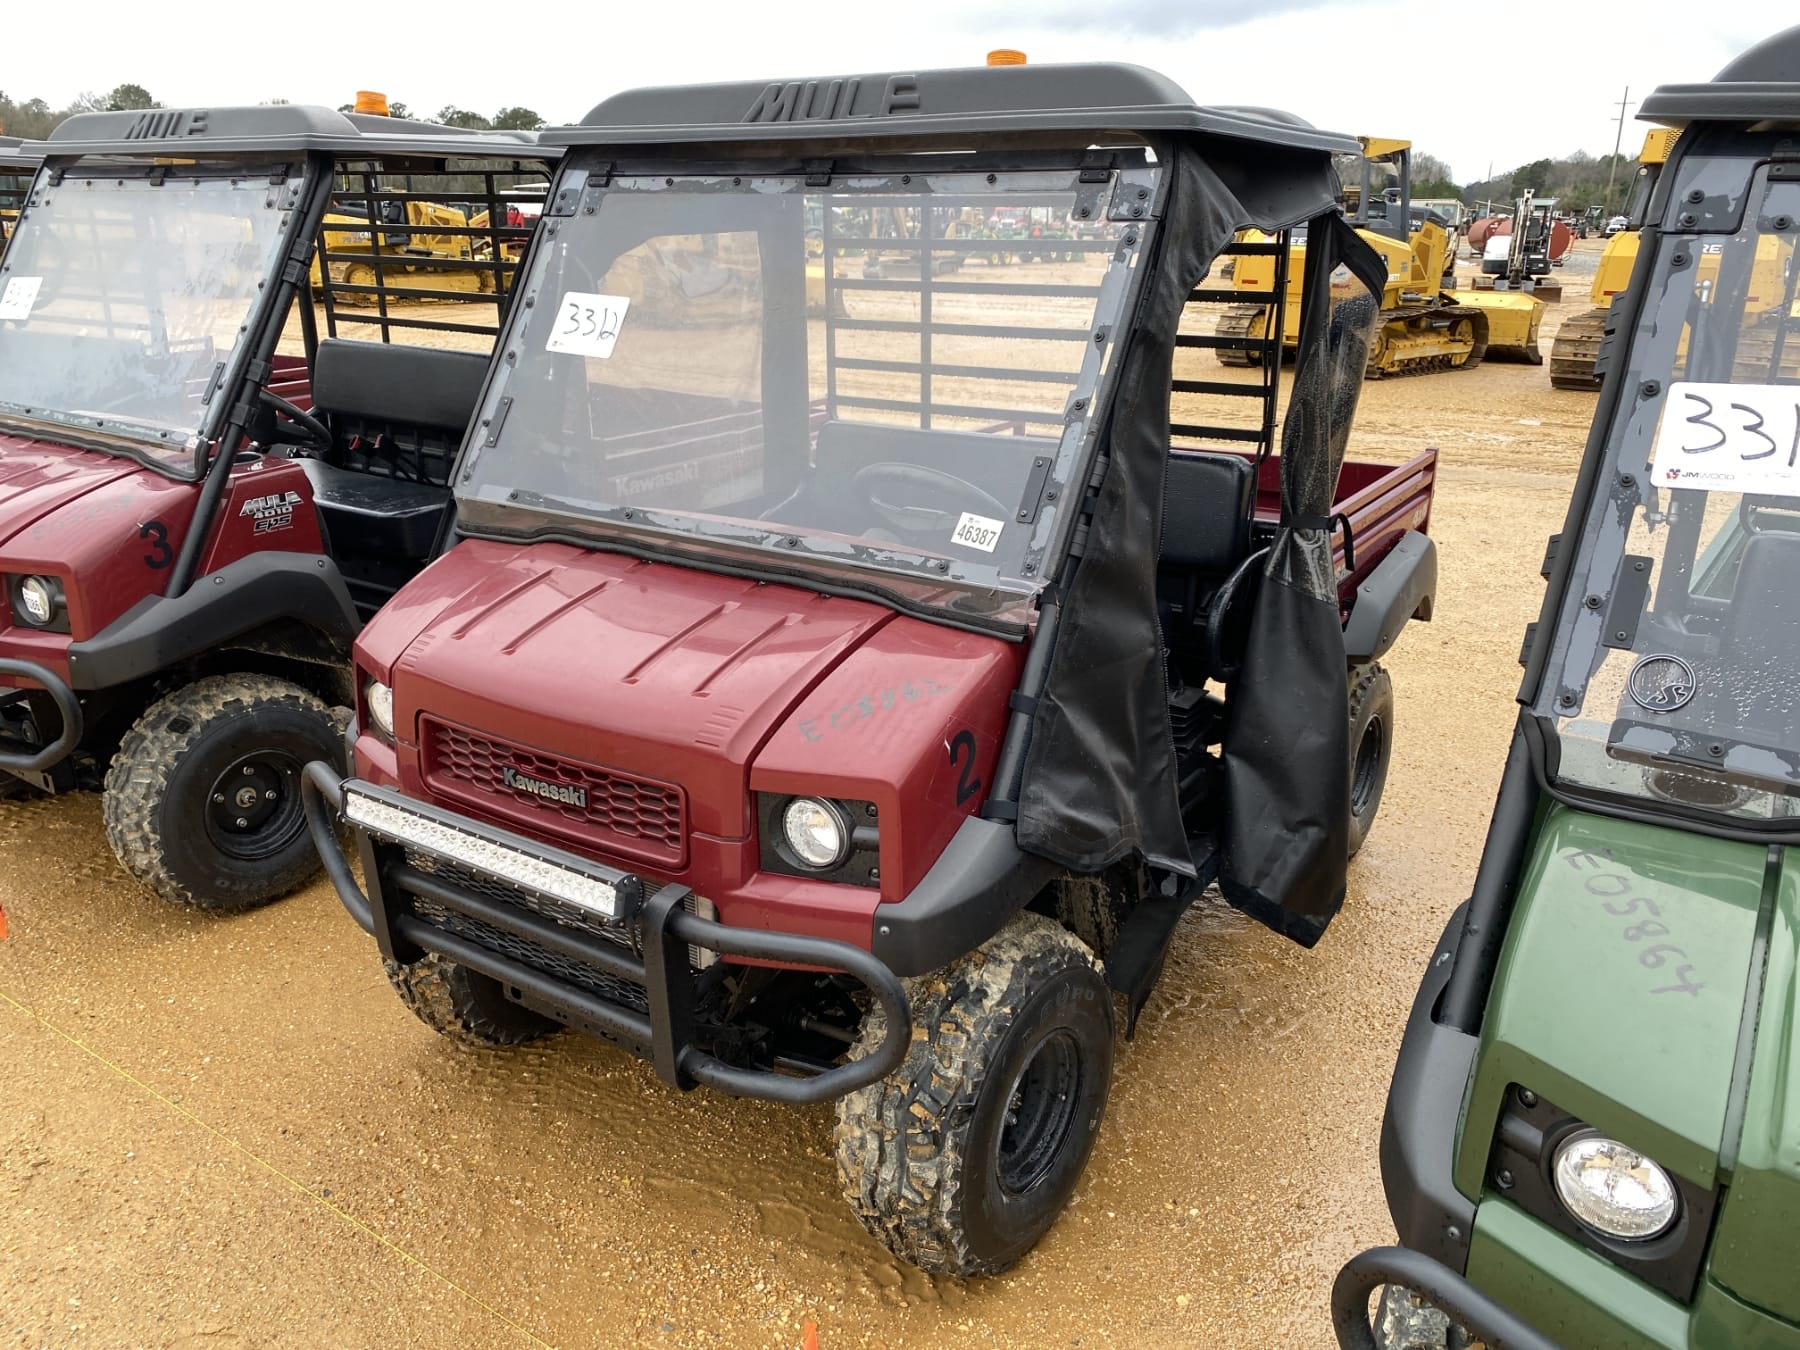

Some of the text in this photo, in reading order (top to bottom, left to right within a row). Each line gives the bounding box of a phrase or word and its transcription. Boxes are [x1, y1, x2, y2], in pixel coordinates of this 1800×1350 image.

[740, 74, 920, 123] MULE
[124, 111, 208, 139] MULE
[562, 302, 618, 341] 3312
[615, 460, 699, 498] Kawasaki
[239, 491, 304, 516] MULE
[139, 521, 173, 570] 3
[957, 523, 997, 547] 46387
[503, 766, 586, 808] Kawasaki
[949, 729, 982, 808] 2
